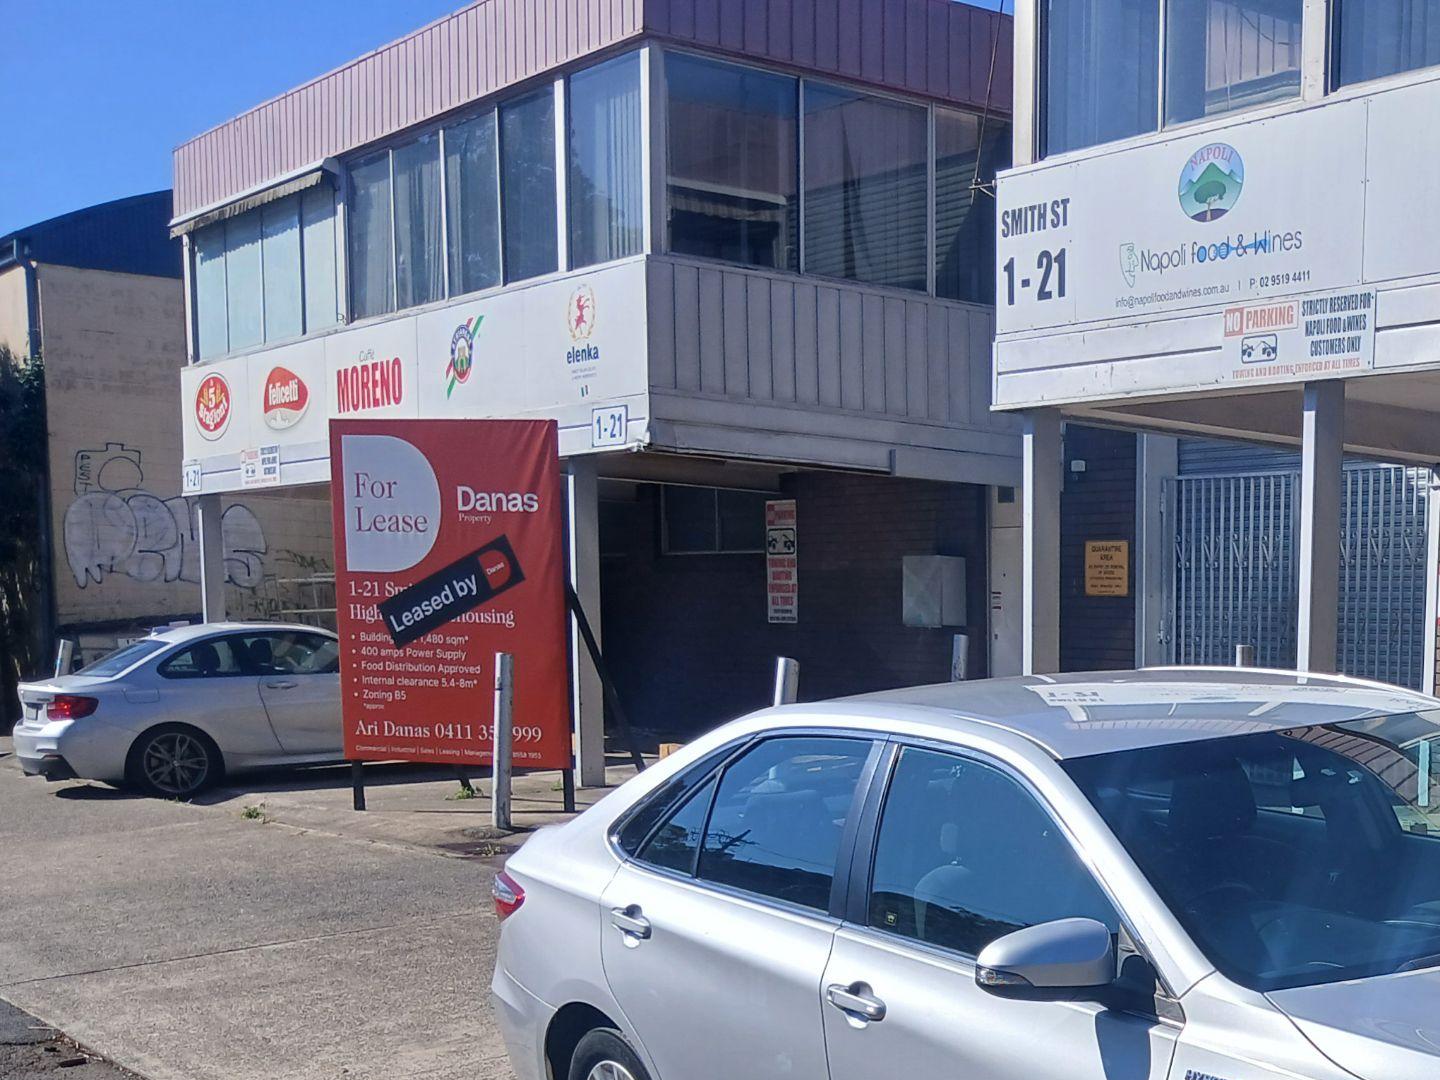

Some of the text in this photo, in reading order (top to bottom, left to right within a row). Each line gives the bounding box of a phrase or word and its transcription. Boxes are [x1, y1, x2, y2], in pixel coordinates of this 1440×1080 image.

[1190, 146, 1234, 171] NAPOLI
[1001, 198, 1071, 238] SMITH ST
[1140, 229, 1303, 275] Napoli food & Wines
[1259, 275, 1270, 288] 02
[1271, 272, 1291, 286] 9519
[1292, 269, 1311, 283] 4411
[1301, 299, 1329, 317] STRICTLY
[1329, 295, 1358, 313] RESERVED
[1226, 305, 1295, 333] NO PARKING
[566, 344, 600, 364] elenka
[268, 377, 299, 406] felicetti
[337, 357, 402, 413] MORENO
[595, 413, 623, 439] 1-21
[354, 472, 398, 499] For
[456, 485, 539, 513] Danas
[355, 506, 429, 533] Lease
[458, 512, 493, 525] Property
[349, 580, 380, 597] 1-21
[389, 573, 480, 633] Leased by
[359, 631, 395, 645] Building
[361, 646, 467, 660] 400 amps Power Supply
[361, 662, 481, 674] Food Distribution Approved
[362, 675, 395, 686] Internal
[396, 676, 440, 687] clearance
[362, 690, 407, 702] Zoning B5
[355, 719, 379, 736] Ari
[383, 720, 430, 738] Danas
[434, 722, 473, 740] 0411
[511, 726, 543, 743] 999
